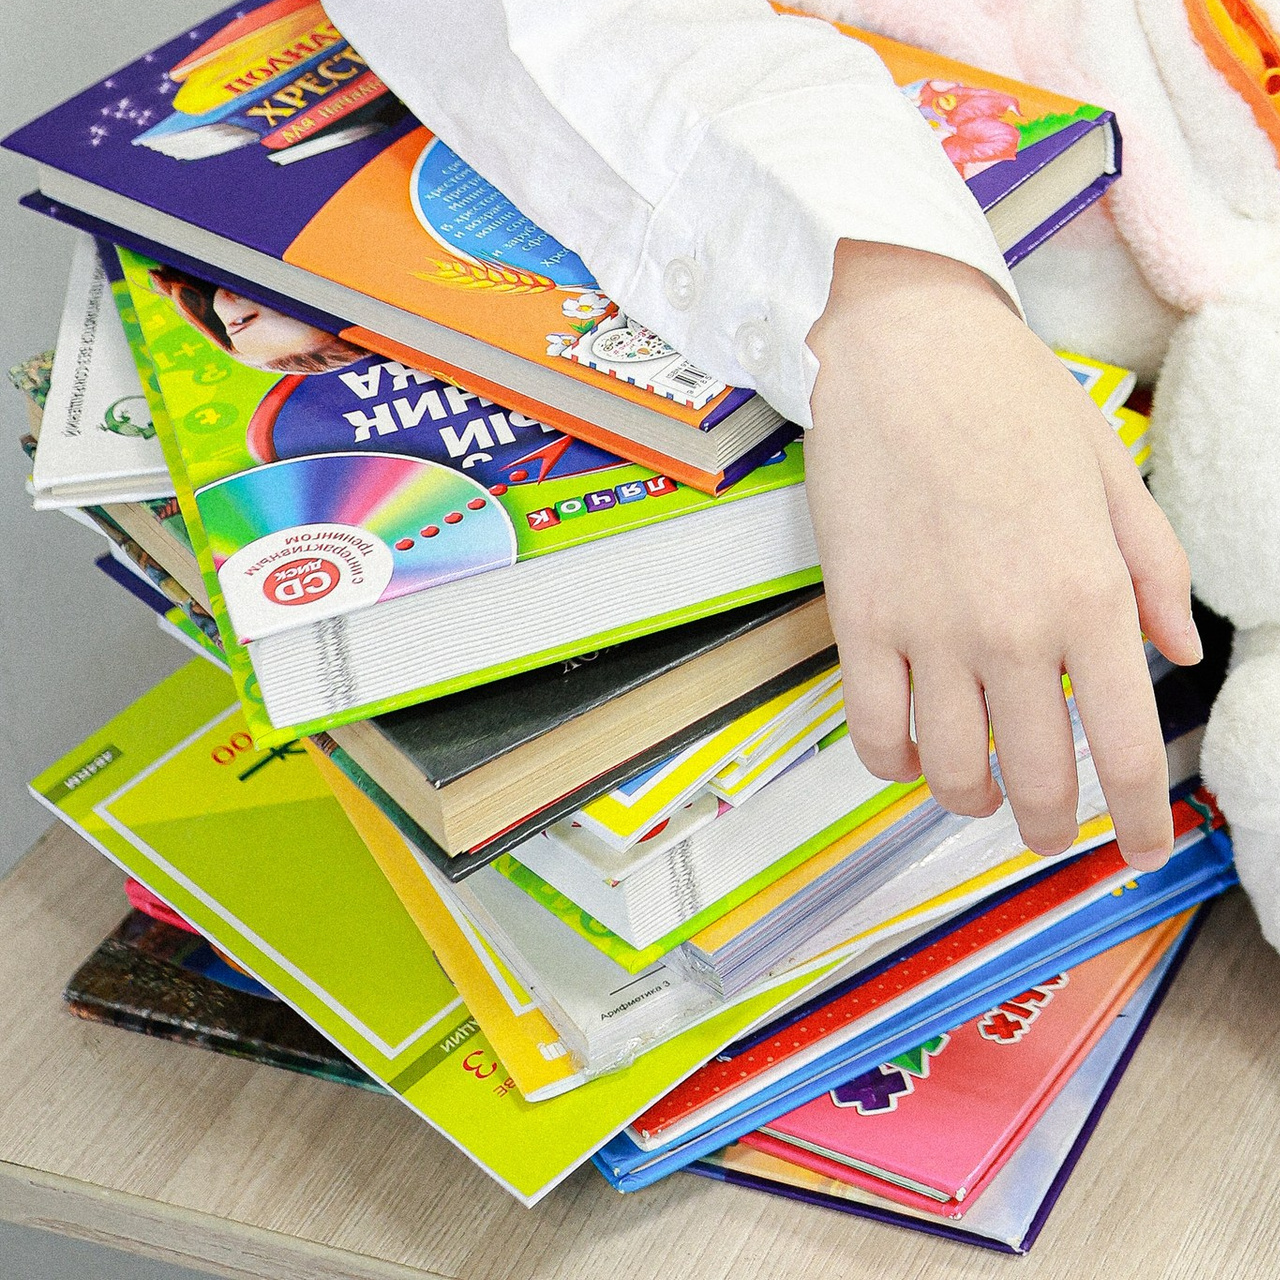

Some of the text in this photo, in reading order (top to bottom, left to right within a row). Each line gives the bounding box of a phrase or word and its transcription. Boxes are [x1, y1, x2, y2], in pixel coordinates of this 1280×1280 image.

[224, 24, 340, 94] ПОЛНА
[245, 543, 364, 576] интерактивным
[285, 531, 374, 557] тренингом
[274, 571, 332, 602] CD
[663, 980, 671, 988] 3
